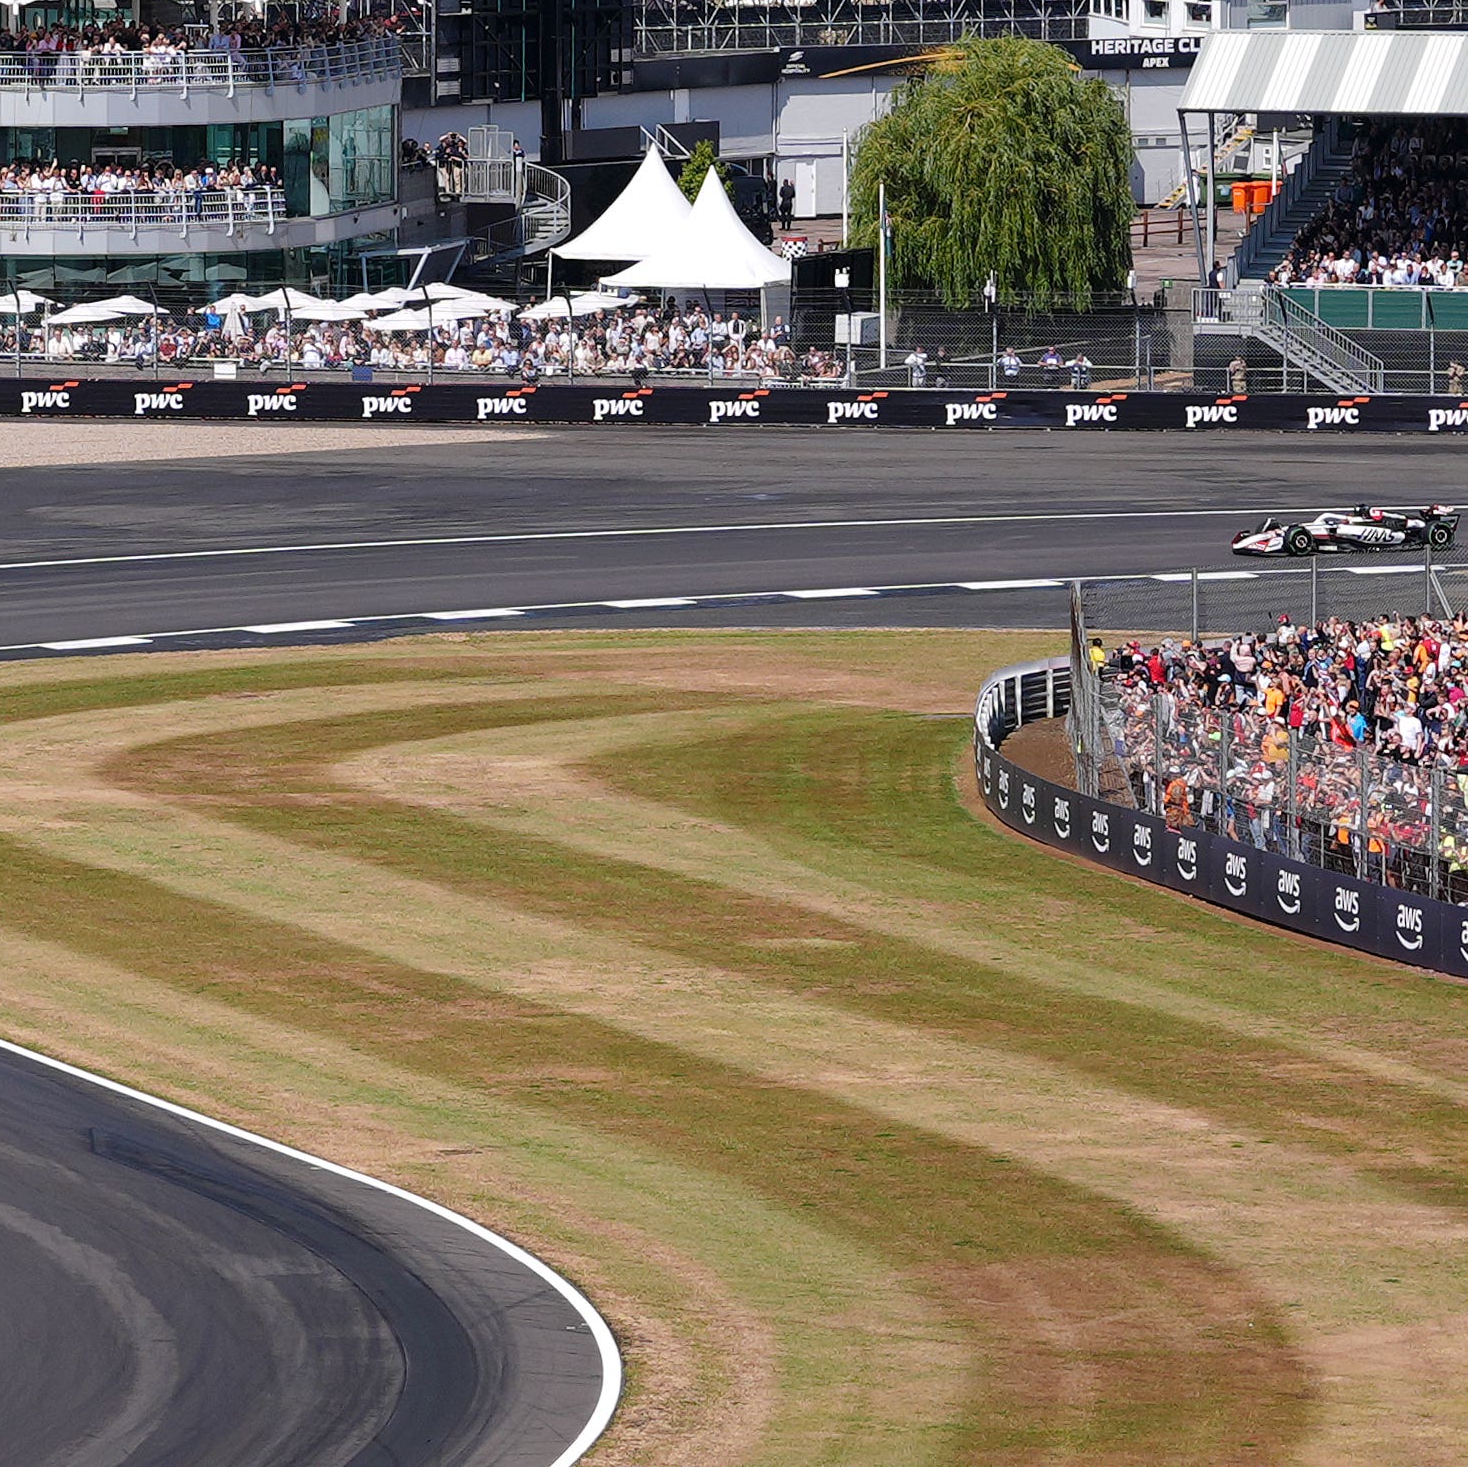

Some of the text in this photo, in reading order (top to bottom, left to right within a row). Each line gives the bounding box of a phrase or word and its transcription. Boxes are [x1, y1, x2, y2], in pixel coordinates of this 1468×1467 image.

[1091, 39, 1175, 55] HERITAGE
[1143, 57, 1169, 68] APEX
[20, 391, 70, 413] pwc
[134, 393, 184, 415] pwc
[247, 394, 297, 416] pwc
[361, 396, 412, 418] pwc
[476, 397, 527, 420] pwc
[592, 398, 644, 421] pwc
[708, 400, 760, 423] pwc
[826, 401, 879, 424] pwc
[945, 403, 997, 426] pwc
[1065, 404, 1118, 427] pwc
[1185, 405, 1238, 428] pwc
[1306, 407, 1360, 429] pwc
[1428, 408, 1468, 430] pw
[1091, 811, 1108, 836] aws
[1133, 823, 1151, 850] aws
[1177, 837, 1196, 865] aws
[1225, 852, 1247, 880] aws
[1277, 869, 1300, 897] aws
[1334, 886, 1359, 915] aws
[1396, 904, 1423, 933] aws
